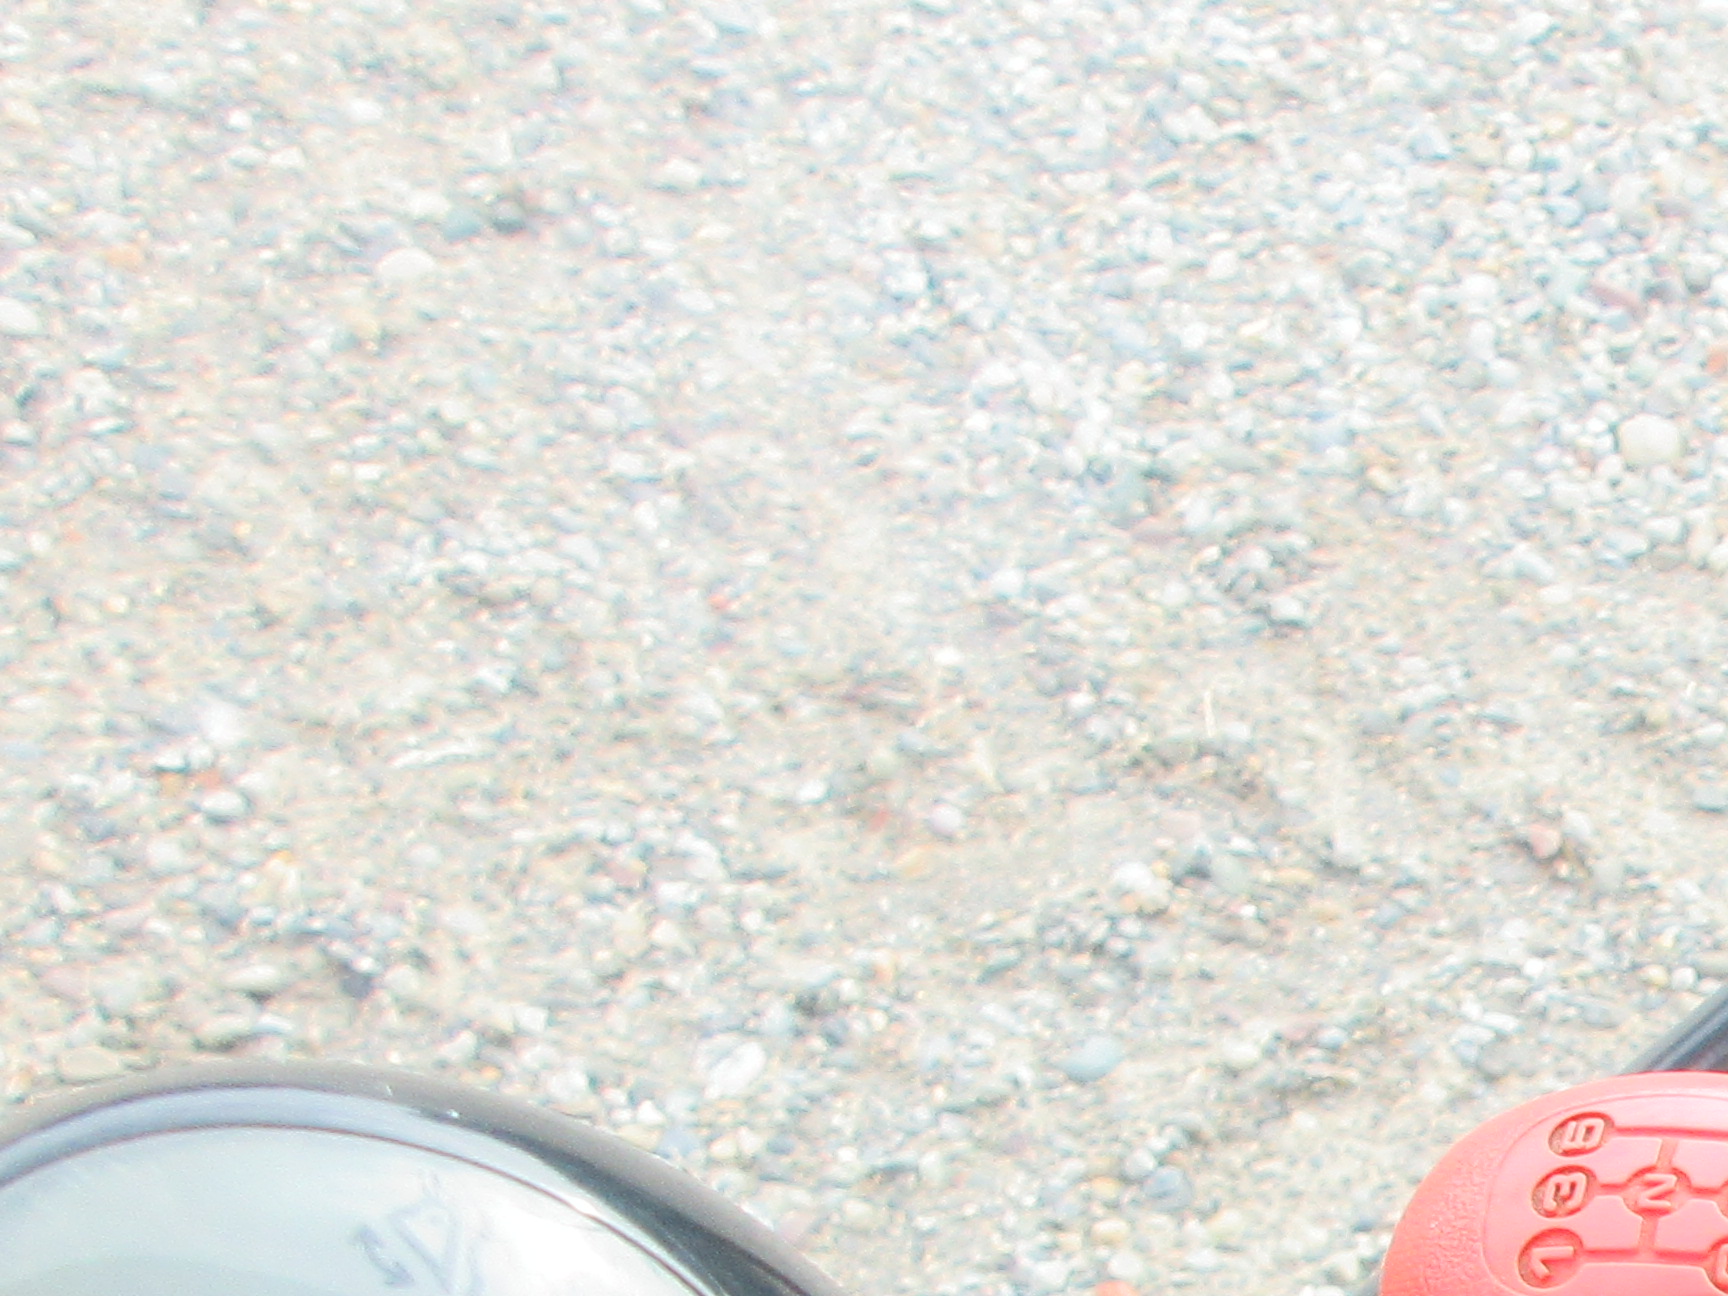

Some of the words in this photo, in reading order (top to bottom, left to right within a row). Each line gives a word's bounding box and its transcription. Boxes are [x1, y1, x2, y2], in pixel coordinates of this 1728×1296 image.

[1544, 1171, 1589, 1212] 3
[1640, 1172, 1680, 1211] N
[1532, 1243, 1577, 1279] 1
